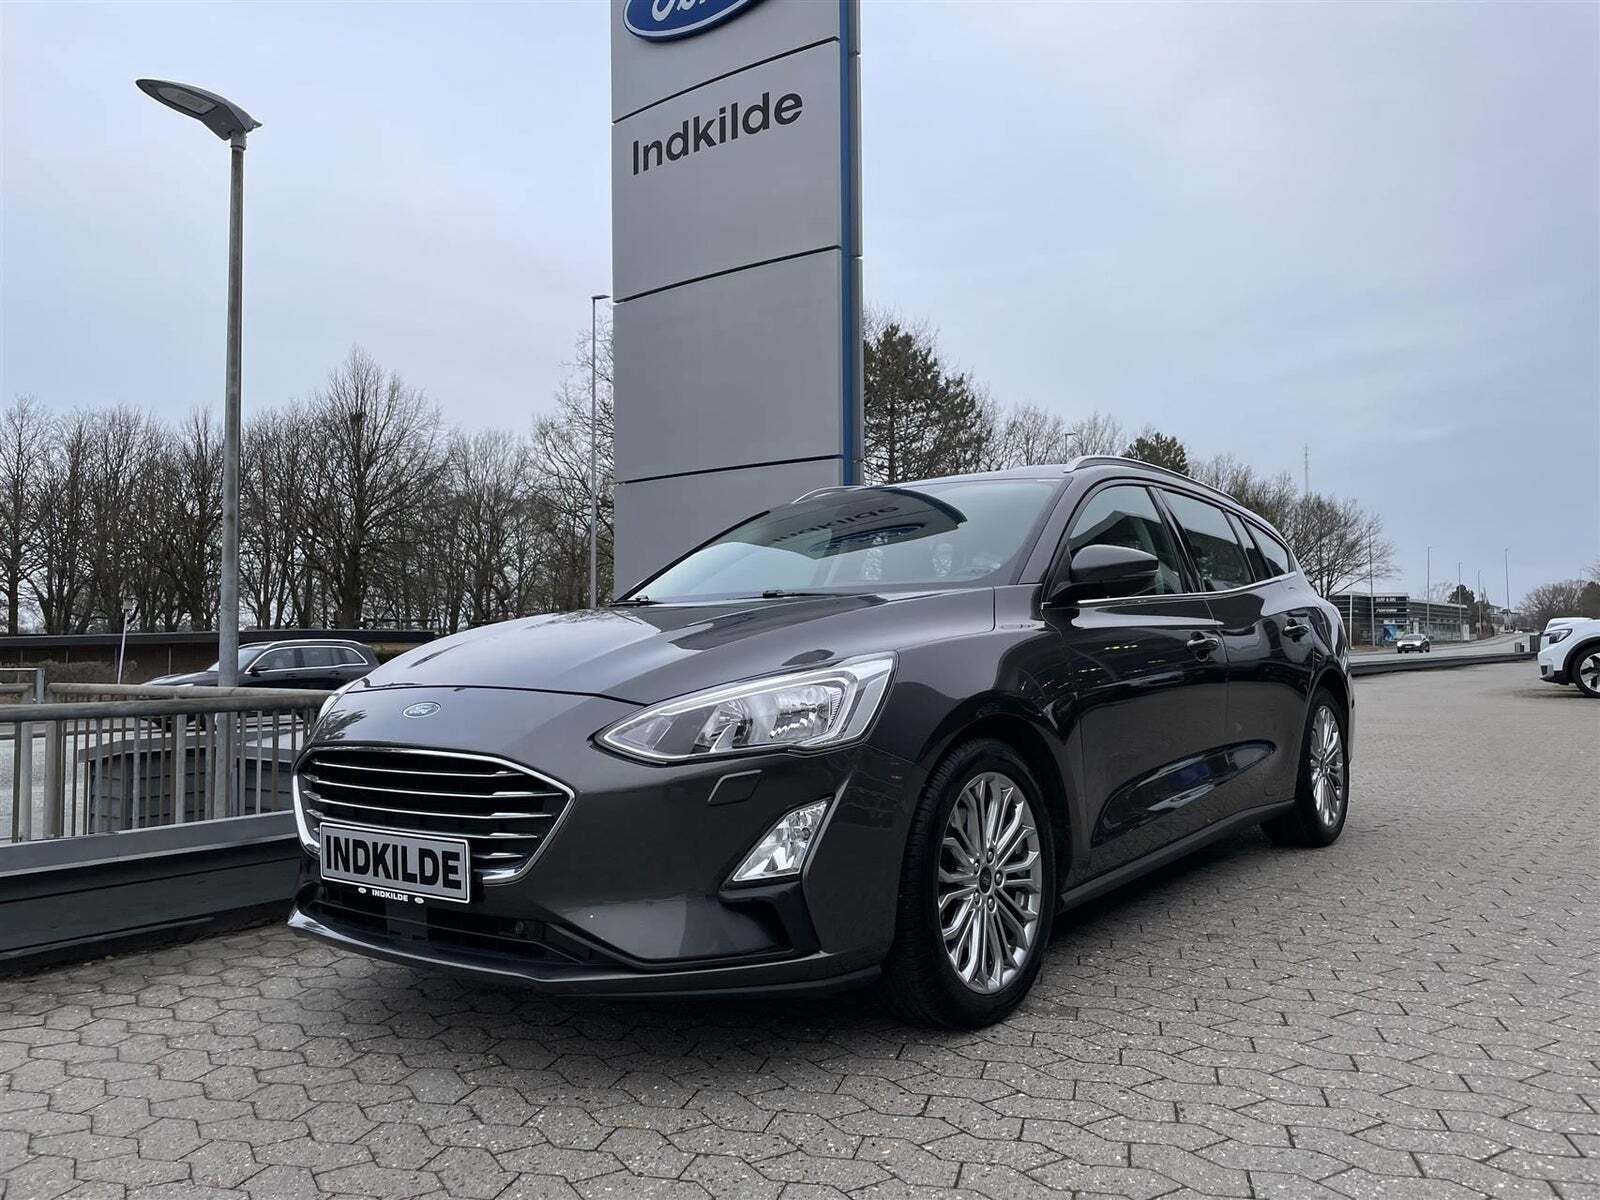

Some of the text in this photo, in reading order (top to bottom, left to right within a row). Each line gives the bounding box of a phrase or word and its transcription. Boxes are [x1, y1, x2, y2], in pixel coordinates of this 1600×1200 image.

[633, 92, 803, 175] Indkilde
[326, 835, 462, 890] INDKILDE
[371, 889, 409, 902] INDKILDE
